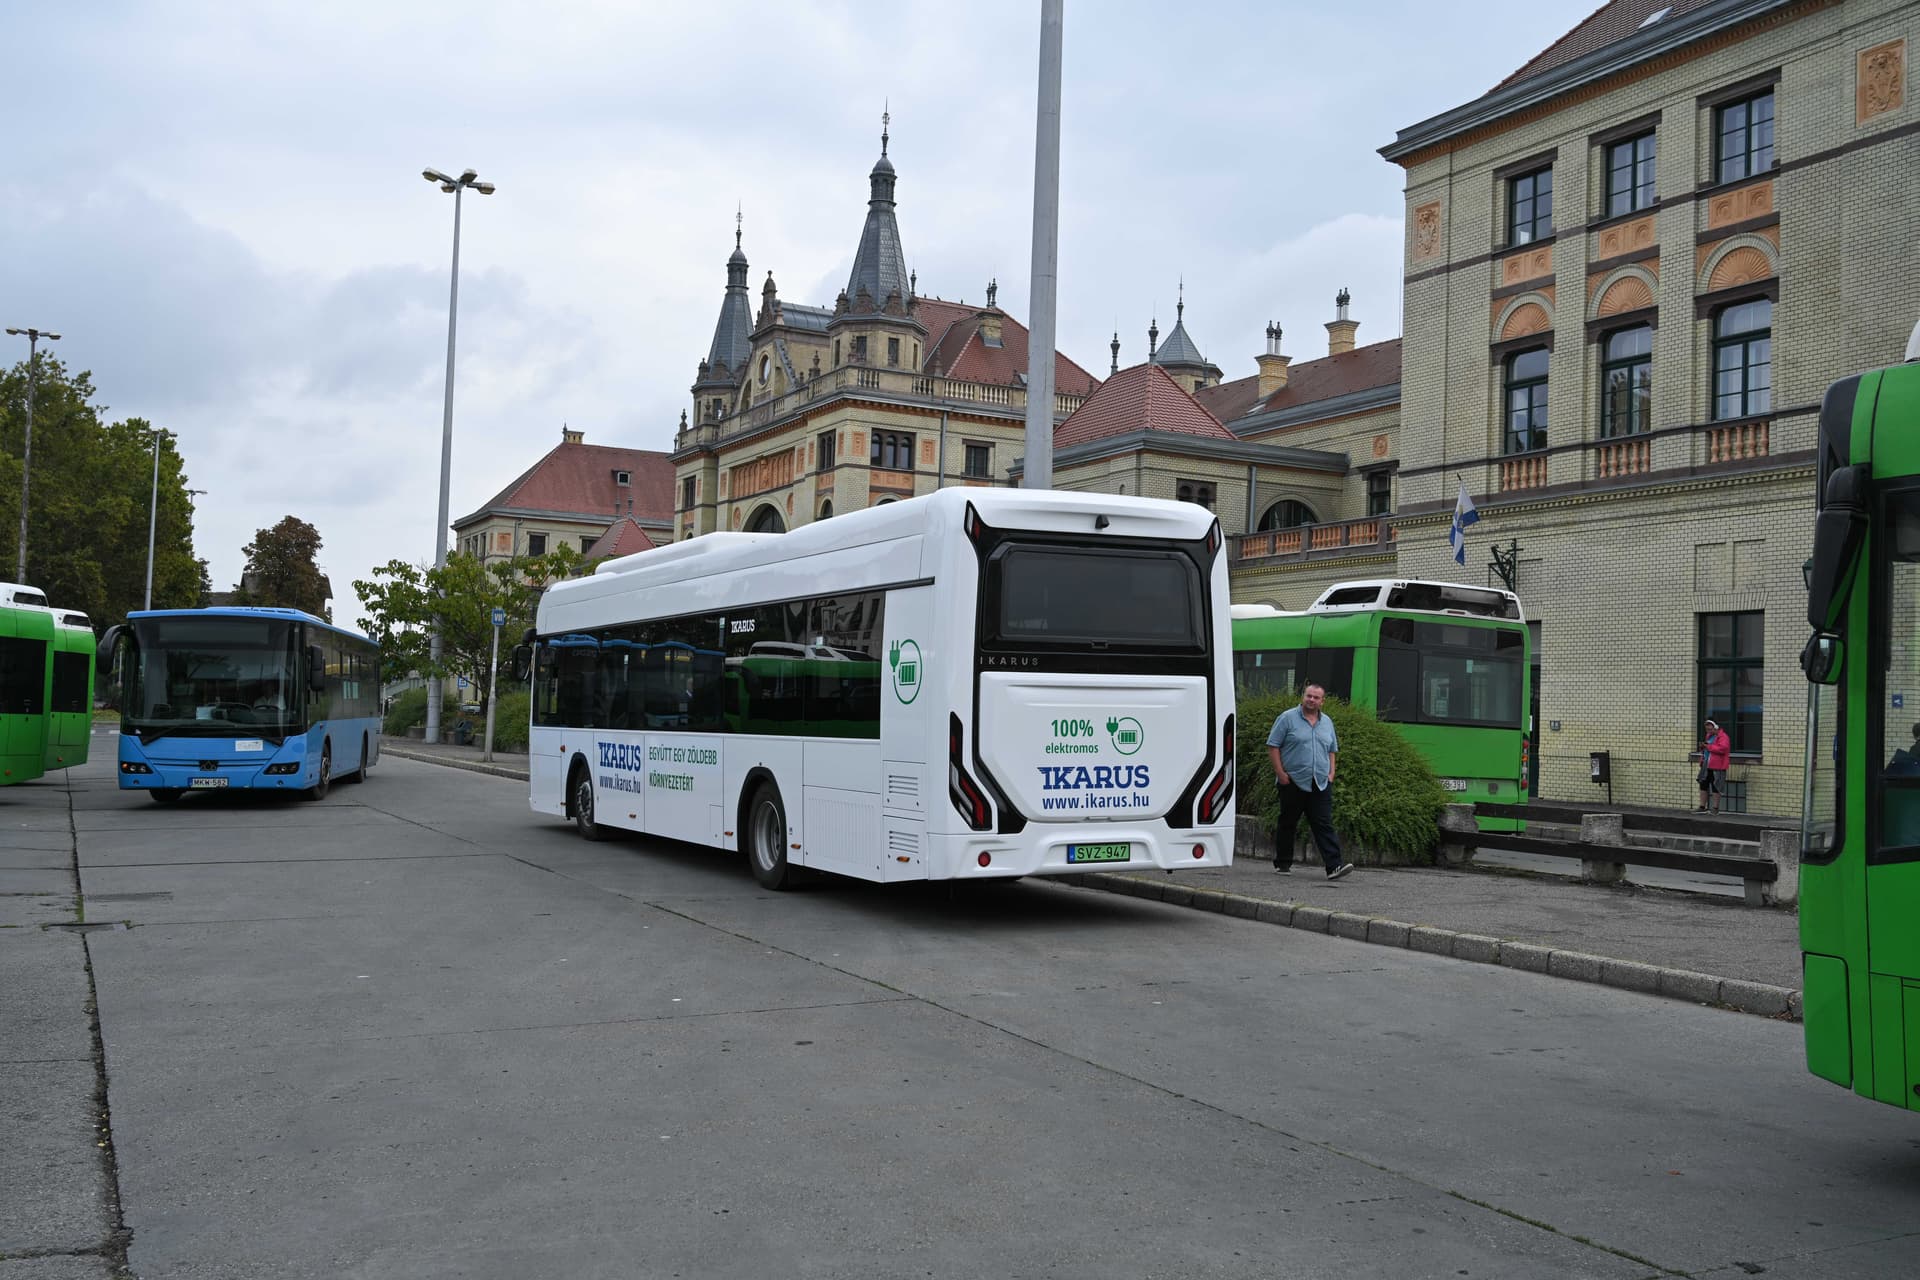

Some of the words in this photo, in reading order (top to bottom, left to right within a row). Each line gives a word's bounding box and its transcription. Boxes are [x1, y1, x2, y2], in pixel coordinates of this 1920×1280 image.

[731, 619, 756, 633] IKARUS
[980, 655, 1039, 666] IKARUS
[1051, 719, 1094, 737] 100%
[598, 742, 641, 772] IKARUS
[649, 744, 672, 762] EGYÜTT
[673, 748, 687, 762] EGY
[687, 746, 718, 765] ZÖLDEBB
[1045, 742, 1099, 754] elektromos
[600, 773, 641, 794] www.ikarus.hu
[649, 770, 694, 792] KÖRNYEZETÉRT
[1037, 765, 1150, 789] IKARUS
[1042, 792, 1149, 809] www.ikarus.hu
[1077, 846, 1127, 859] SVZ-947
